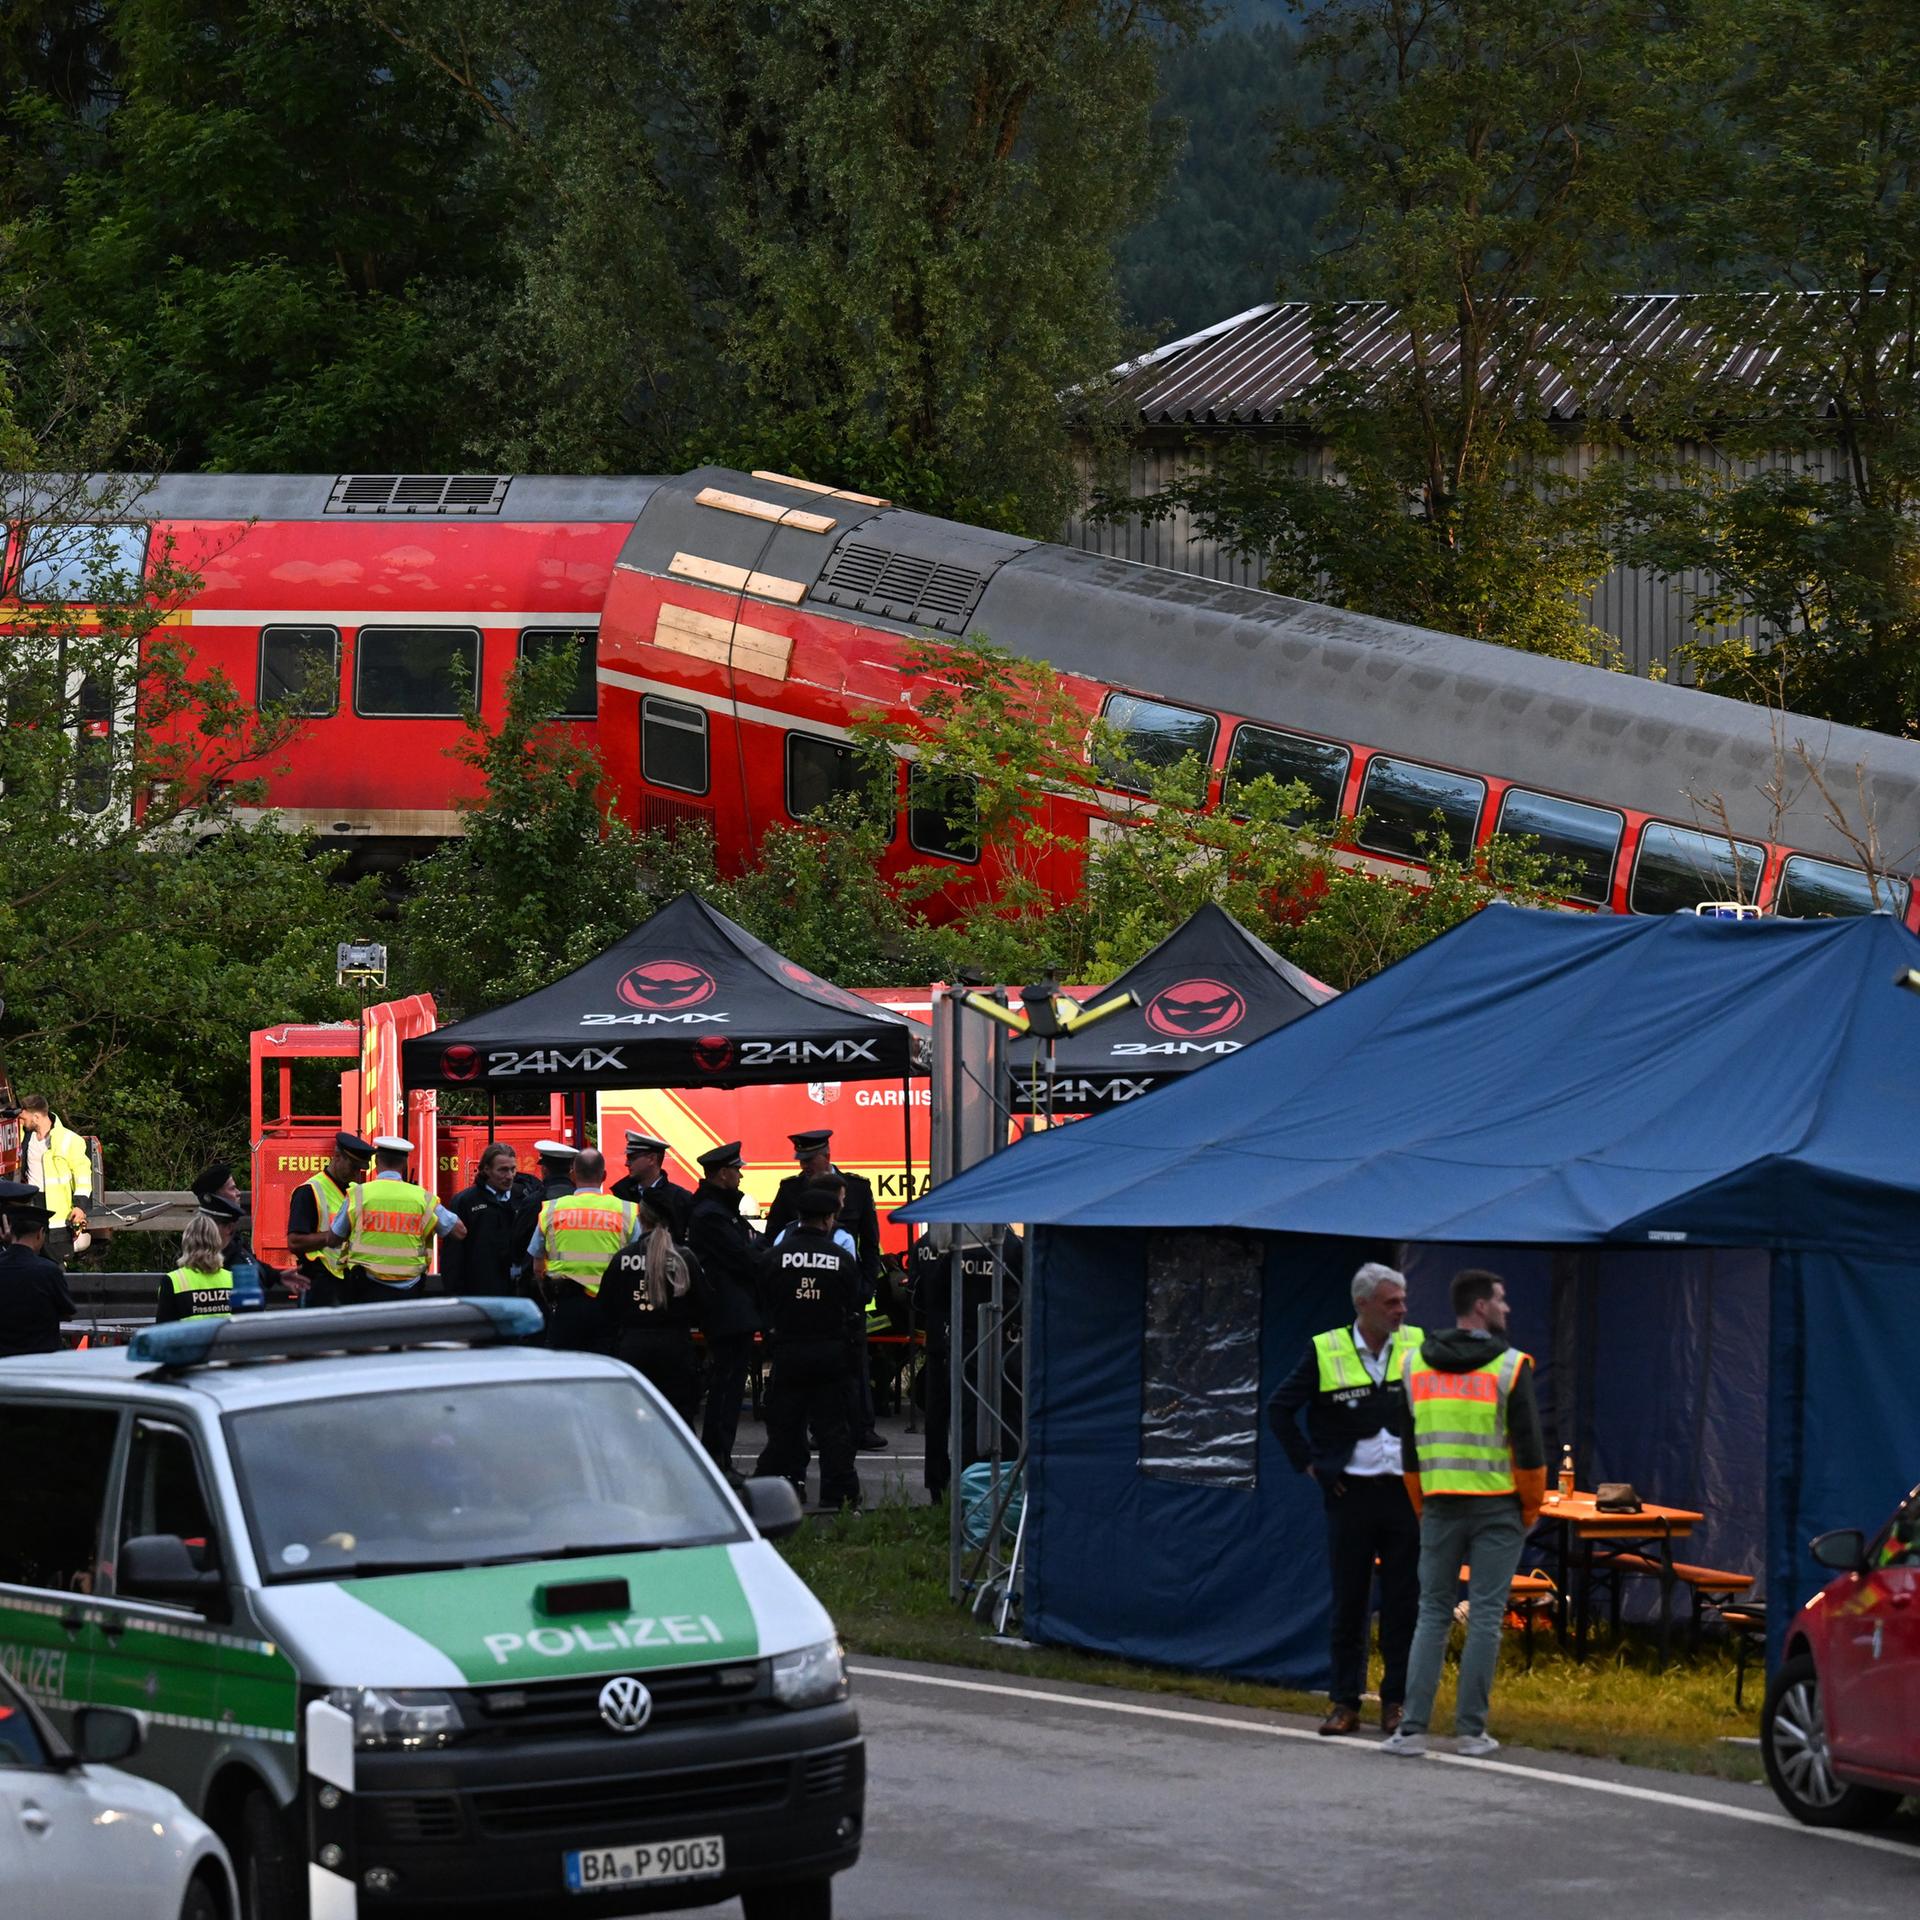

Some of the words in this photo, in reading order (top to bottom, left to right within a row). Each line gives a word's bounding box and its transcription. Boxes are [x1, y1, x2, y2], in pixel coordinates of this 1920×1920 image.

[579, 1012, 731, 1025] 24MX
[488, 1046, 628, 1075] 24MX
[740, 1038, 880, 1064] 24MX
[1016, 1078, 1155, 1102] 24MX
[878, 1174, 931, 1196] KRA
[364, 1212, 424, 1233] POLIZEI
[558, 1209, 620, 1231] POLIZEI
[782, 1252, 840, 1271] POLIZEI
[918, 1246, 939, 1261] POL
[796, 1288, 820, 1300] 5411
[801, 1277, 816, 1289] BY
[1418, 1375, 1491, 1397] POLIZEI
[484, 1614, 724, 1664] POLIZEI
[0, 1644, 67, 1697] OLIZEI
[583, 1853, 617, 1881] BA
